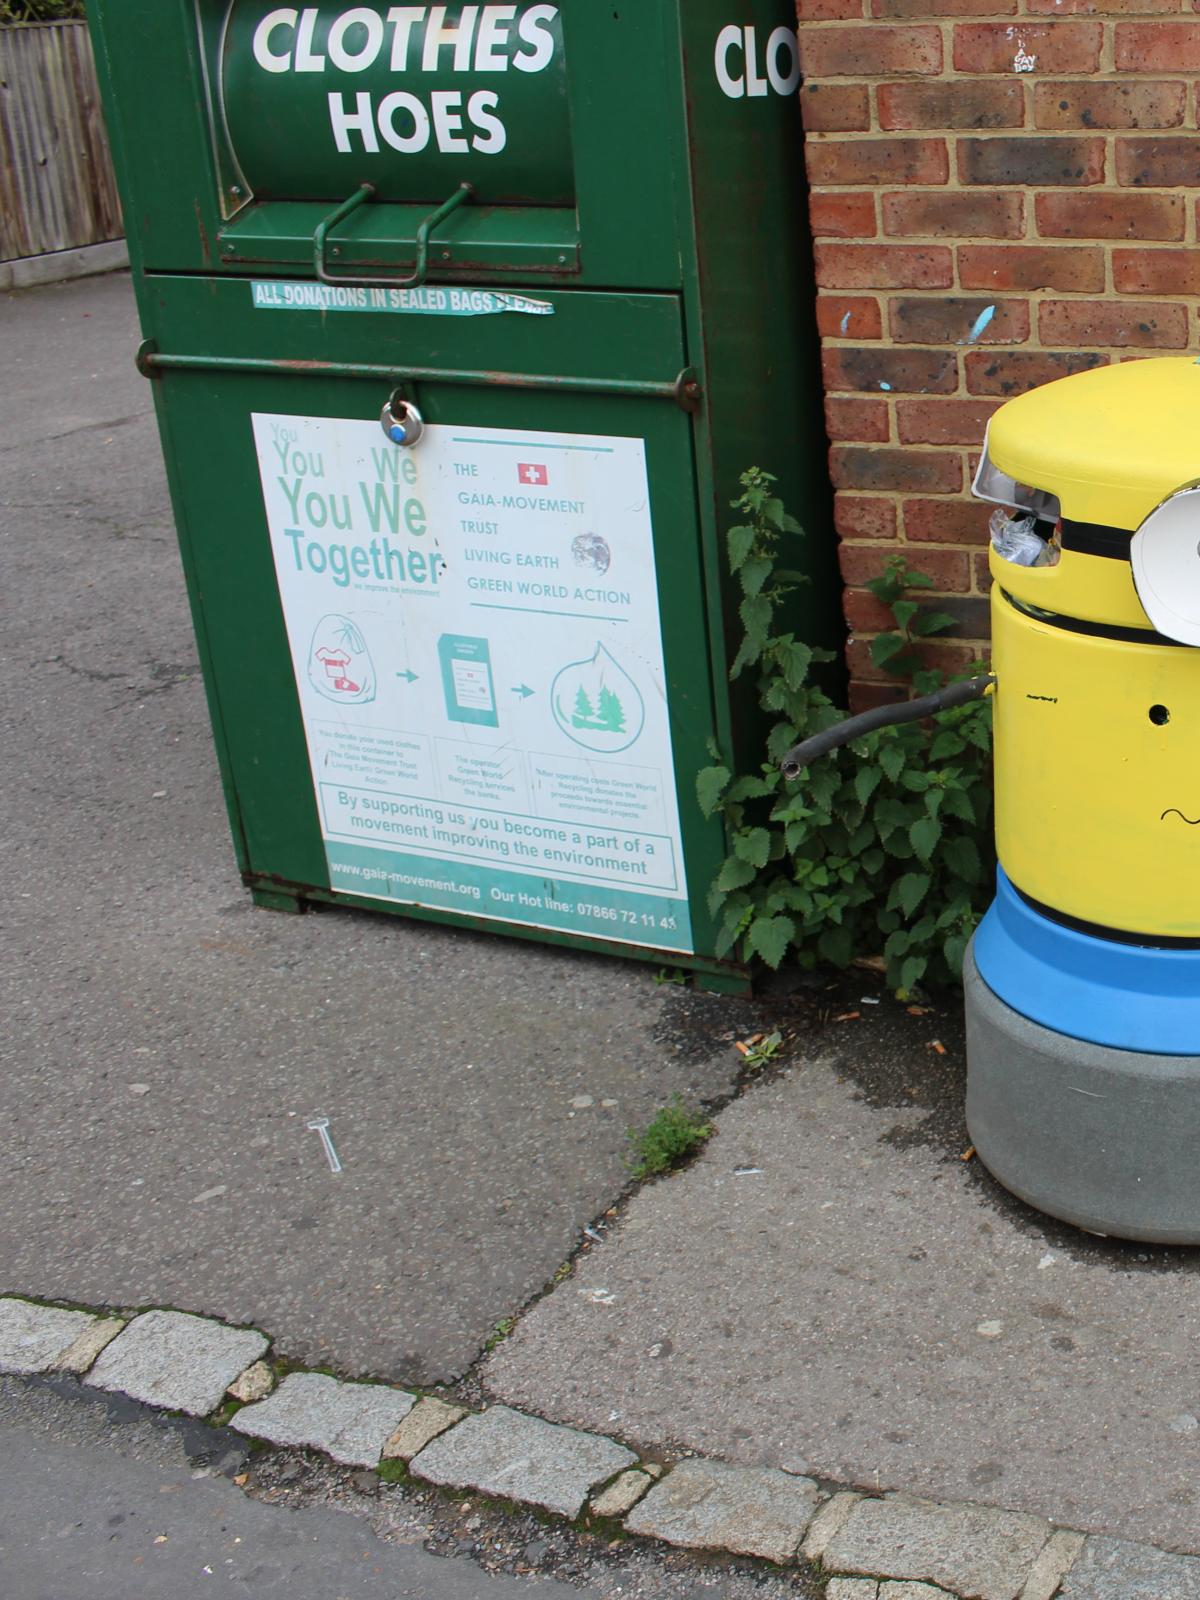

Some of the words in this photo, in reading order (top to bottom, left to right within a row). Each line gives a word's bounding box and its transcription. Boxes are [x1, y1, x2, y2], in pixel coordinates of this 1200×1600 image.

[253, 4, 559, 74] CLOTHES
[327, 90, 507, 154] HOES
[256, 284, 282, 304] ALL
[284, 285, 367, 308] DONATIONS
[371, 287, 386, 308] IN
[390, 288, 446, 311] SEALED
[450, 290, 492, 312] BAGS
[270, 422, 297, 442] You
[273, 440, 325, 478] You
[371, 447, 417, 484] We
[453, 462, 479, 477] THE
[277, 476, 352, 530] You
[359, 481, 427, 537] We
[458, 491, 585, 514] GAIA-MOVEMENT
[460, 520, 498, 535] TRUST
[284, 528, 442, 587] Together
[464, 548, 511, 564] LIVING
[516, 553, 560, 569] EARTH
[467, 576, 513, 593] GREEN
[516, 582, 569, 598] WORLD
[574, 587, 631, 604] ACTION
[338, 791, 358, 810] By
[362, 797, 444, 825] supporting
[448, 812, 465, 825] us
[470, 815, 499, 831] you
[503, 818, 567, 842] become
[571, 832, 581, 844] a
[587, 834, 619, 849] part
[624, 838, 641, 853] of
[645, 843, 655, 855] a
[351, 814, 430, 839] movement
[433, 829, 510, 856] improving
[513, 841, 538, 857] the
[544, 848, 648, 875] environment
[331, 861, 481, 899] www.gaia-movement.org
[491, 887, 515, 902] Our
[518, 892, 542, 908] Hot
[577, 902, 617, 921] 07866
[619, 909, 638, 924] 72
[641, 914, 655, 928] 11
